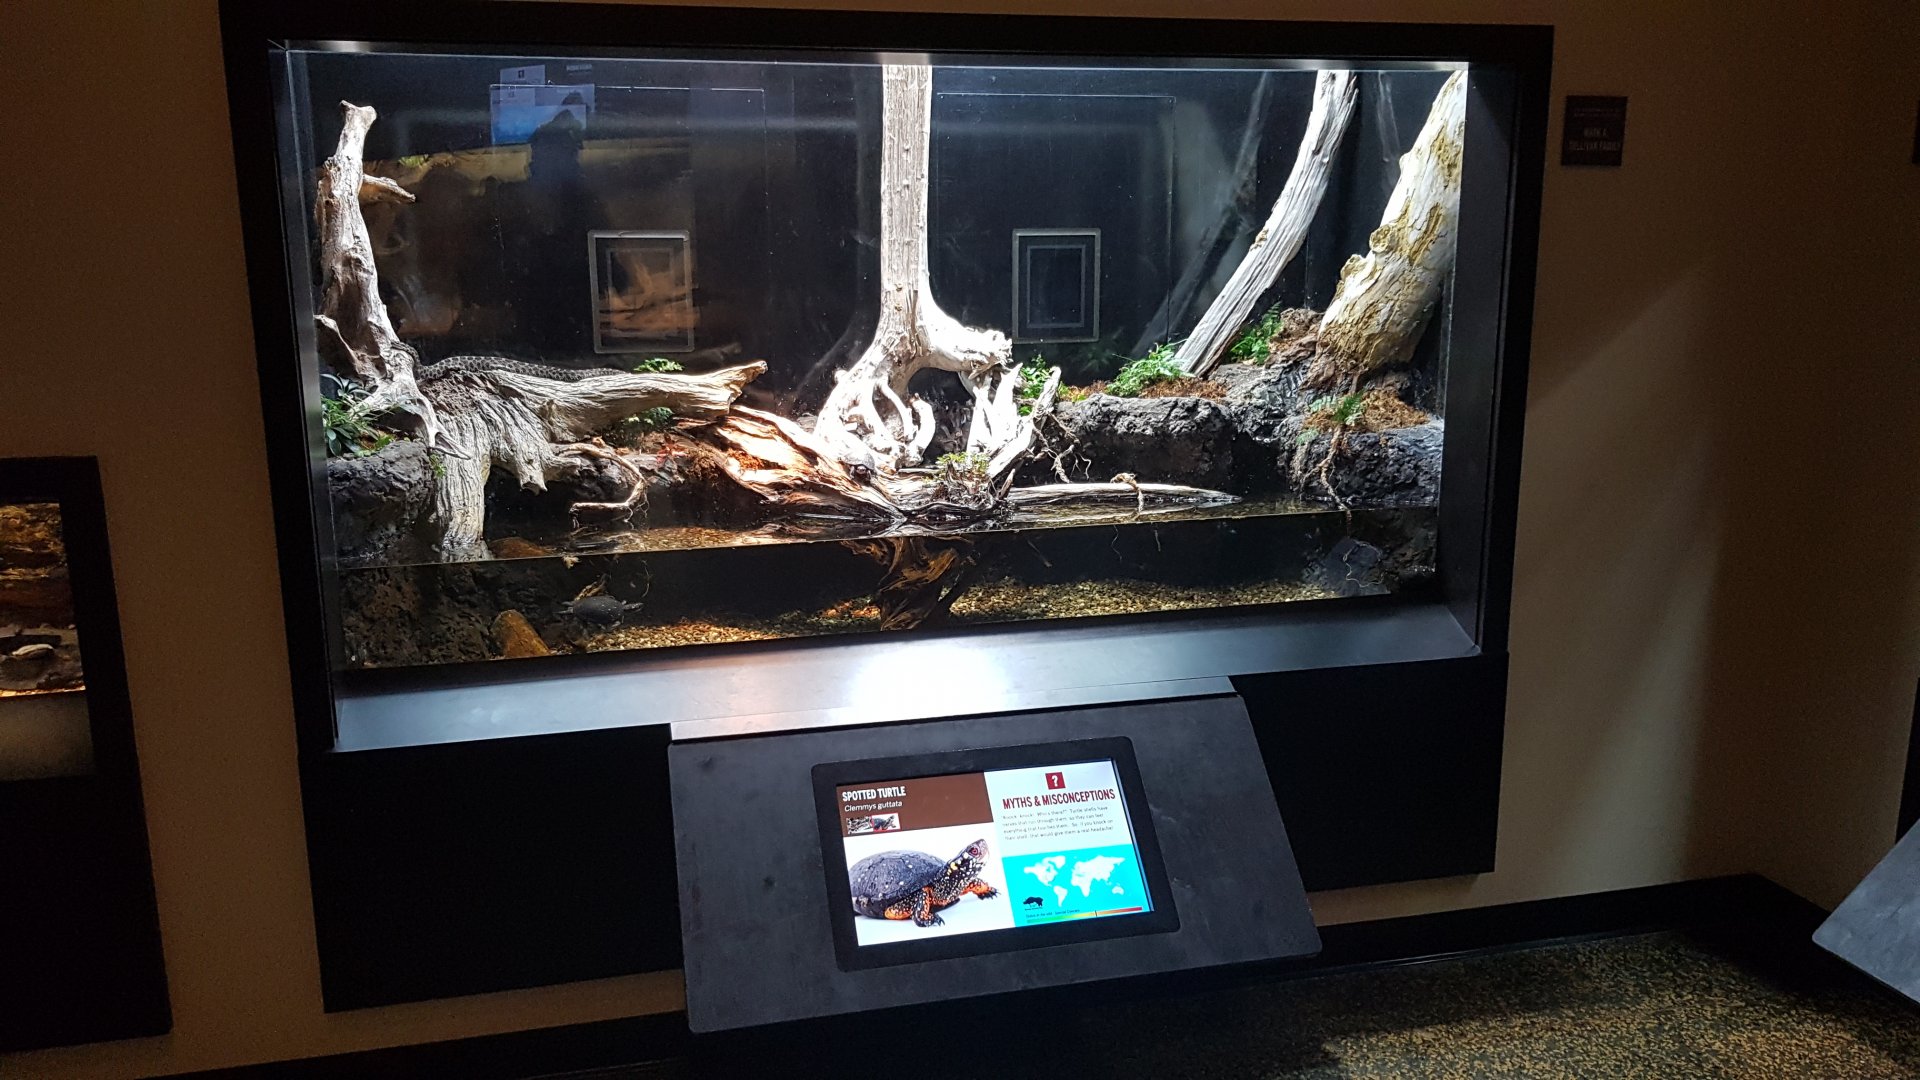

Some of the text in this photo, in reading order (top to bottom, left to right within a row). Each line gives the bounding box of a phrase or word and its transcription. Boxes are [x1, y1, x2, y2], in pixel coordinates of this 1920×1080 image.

[1052, 775, 1058, 786] ?
[842, 786, 906, 802] SPOTTED TURTLE
[1002, 789, 1116, 810] MYTHS & MISCONCEPTIONS
[844, 800, 902, 812] Clemmys guttata
